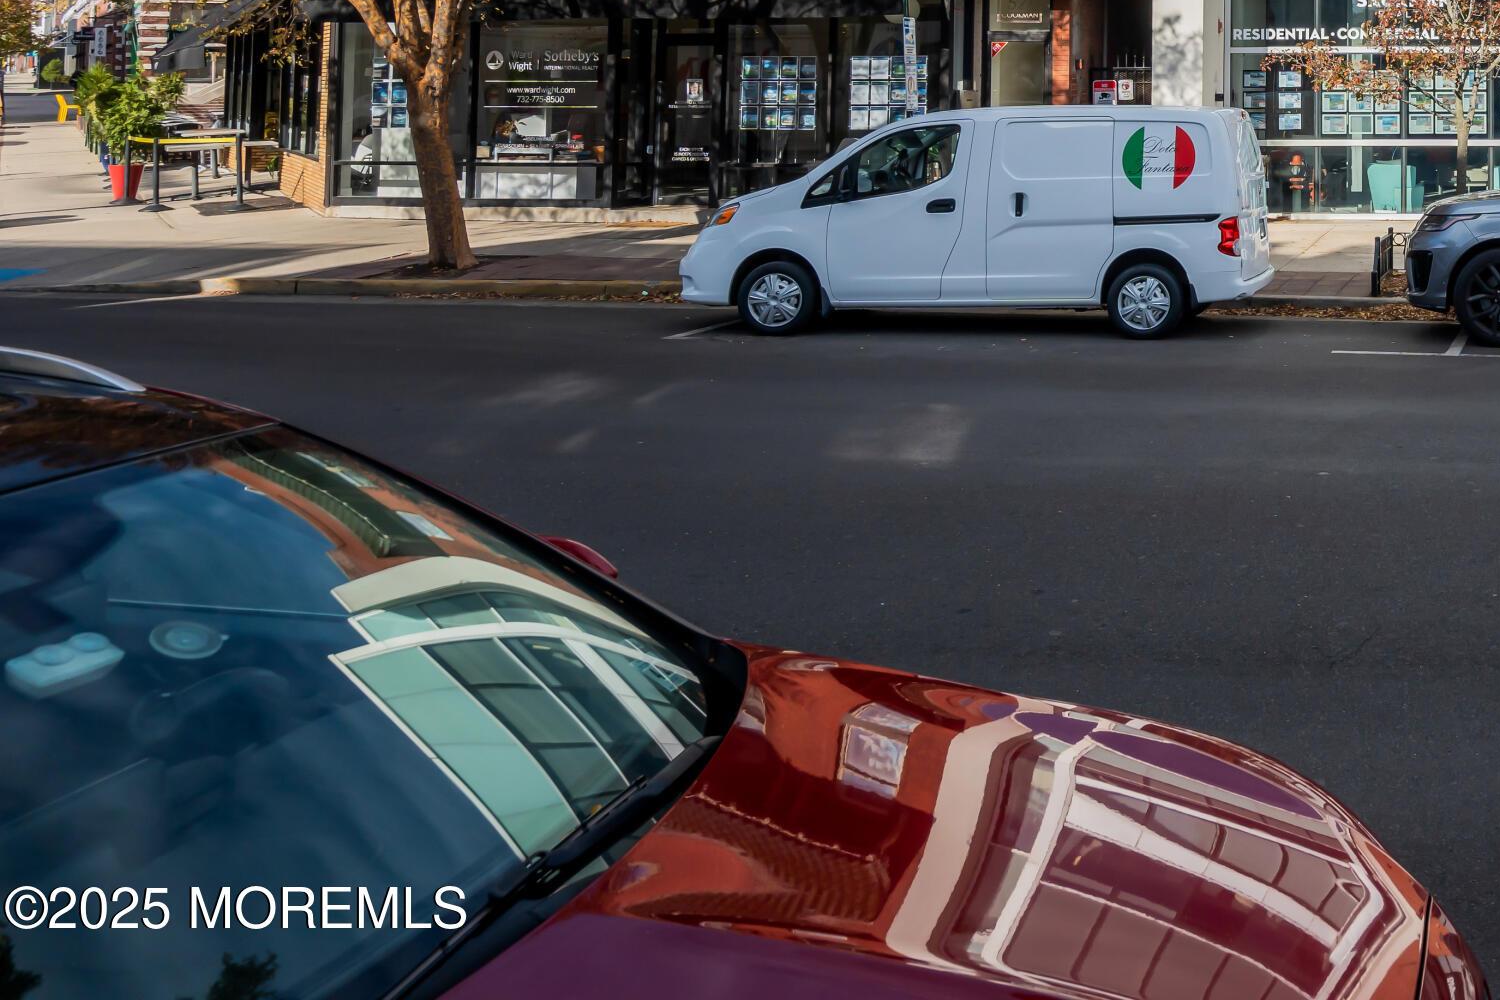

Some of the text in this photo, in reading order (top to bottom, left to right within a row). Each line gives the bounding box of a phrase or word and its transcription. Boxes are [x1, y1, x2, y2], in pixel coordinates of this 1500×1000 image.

[1232, 27, 1330, 41] RESIDENTIAL
[1336, 26, 1440, 41] COERCIAL
[511, 50, 533, 59] Ward
[544, 48, 600, 64] Sotheby's
[508, 61, 533, 72] Wight
[507, 86, 576, 95] www.wardwight.com
[517, 95, 565, 104] 732-775-8500
